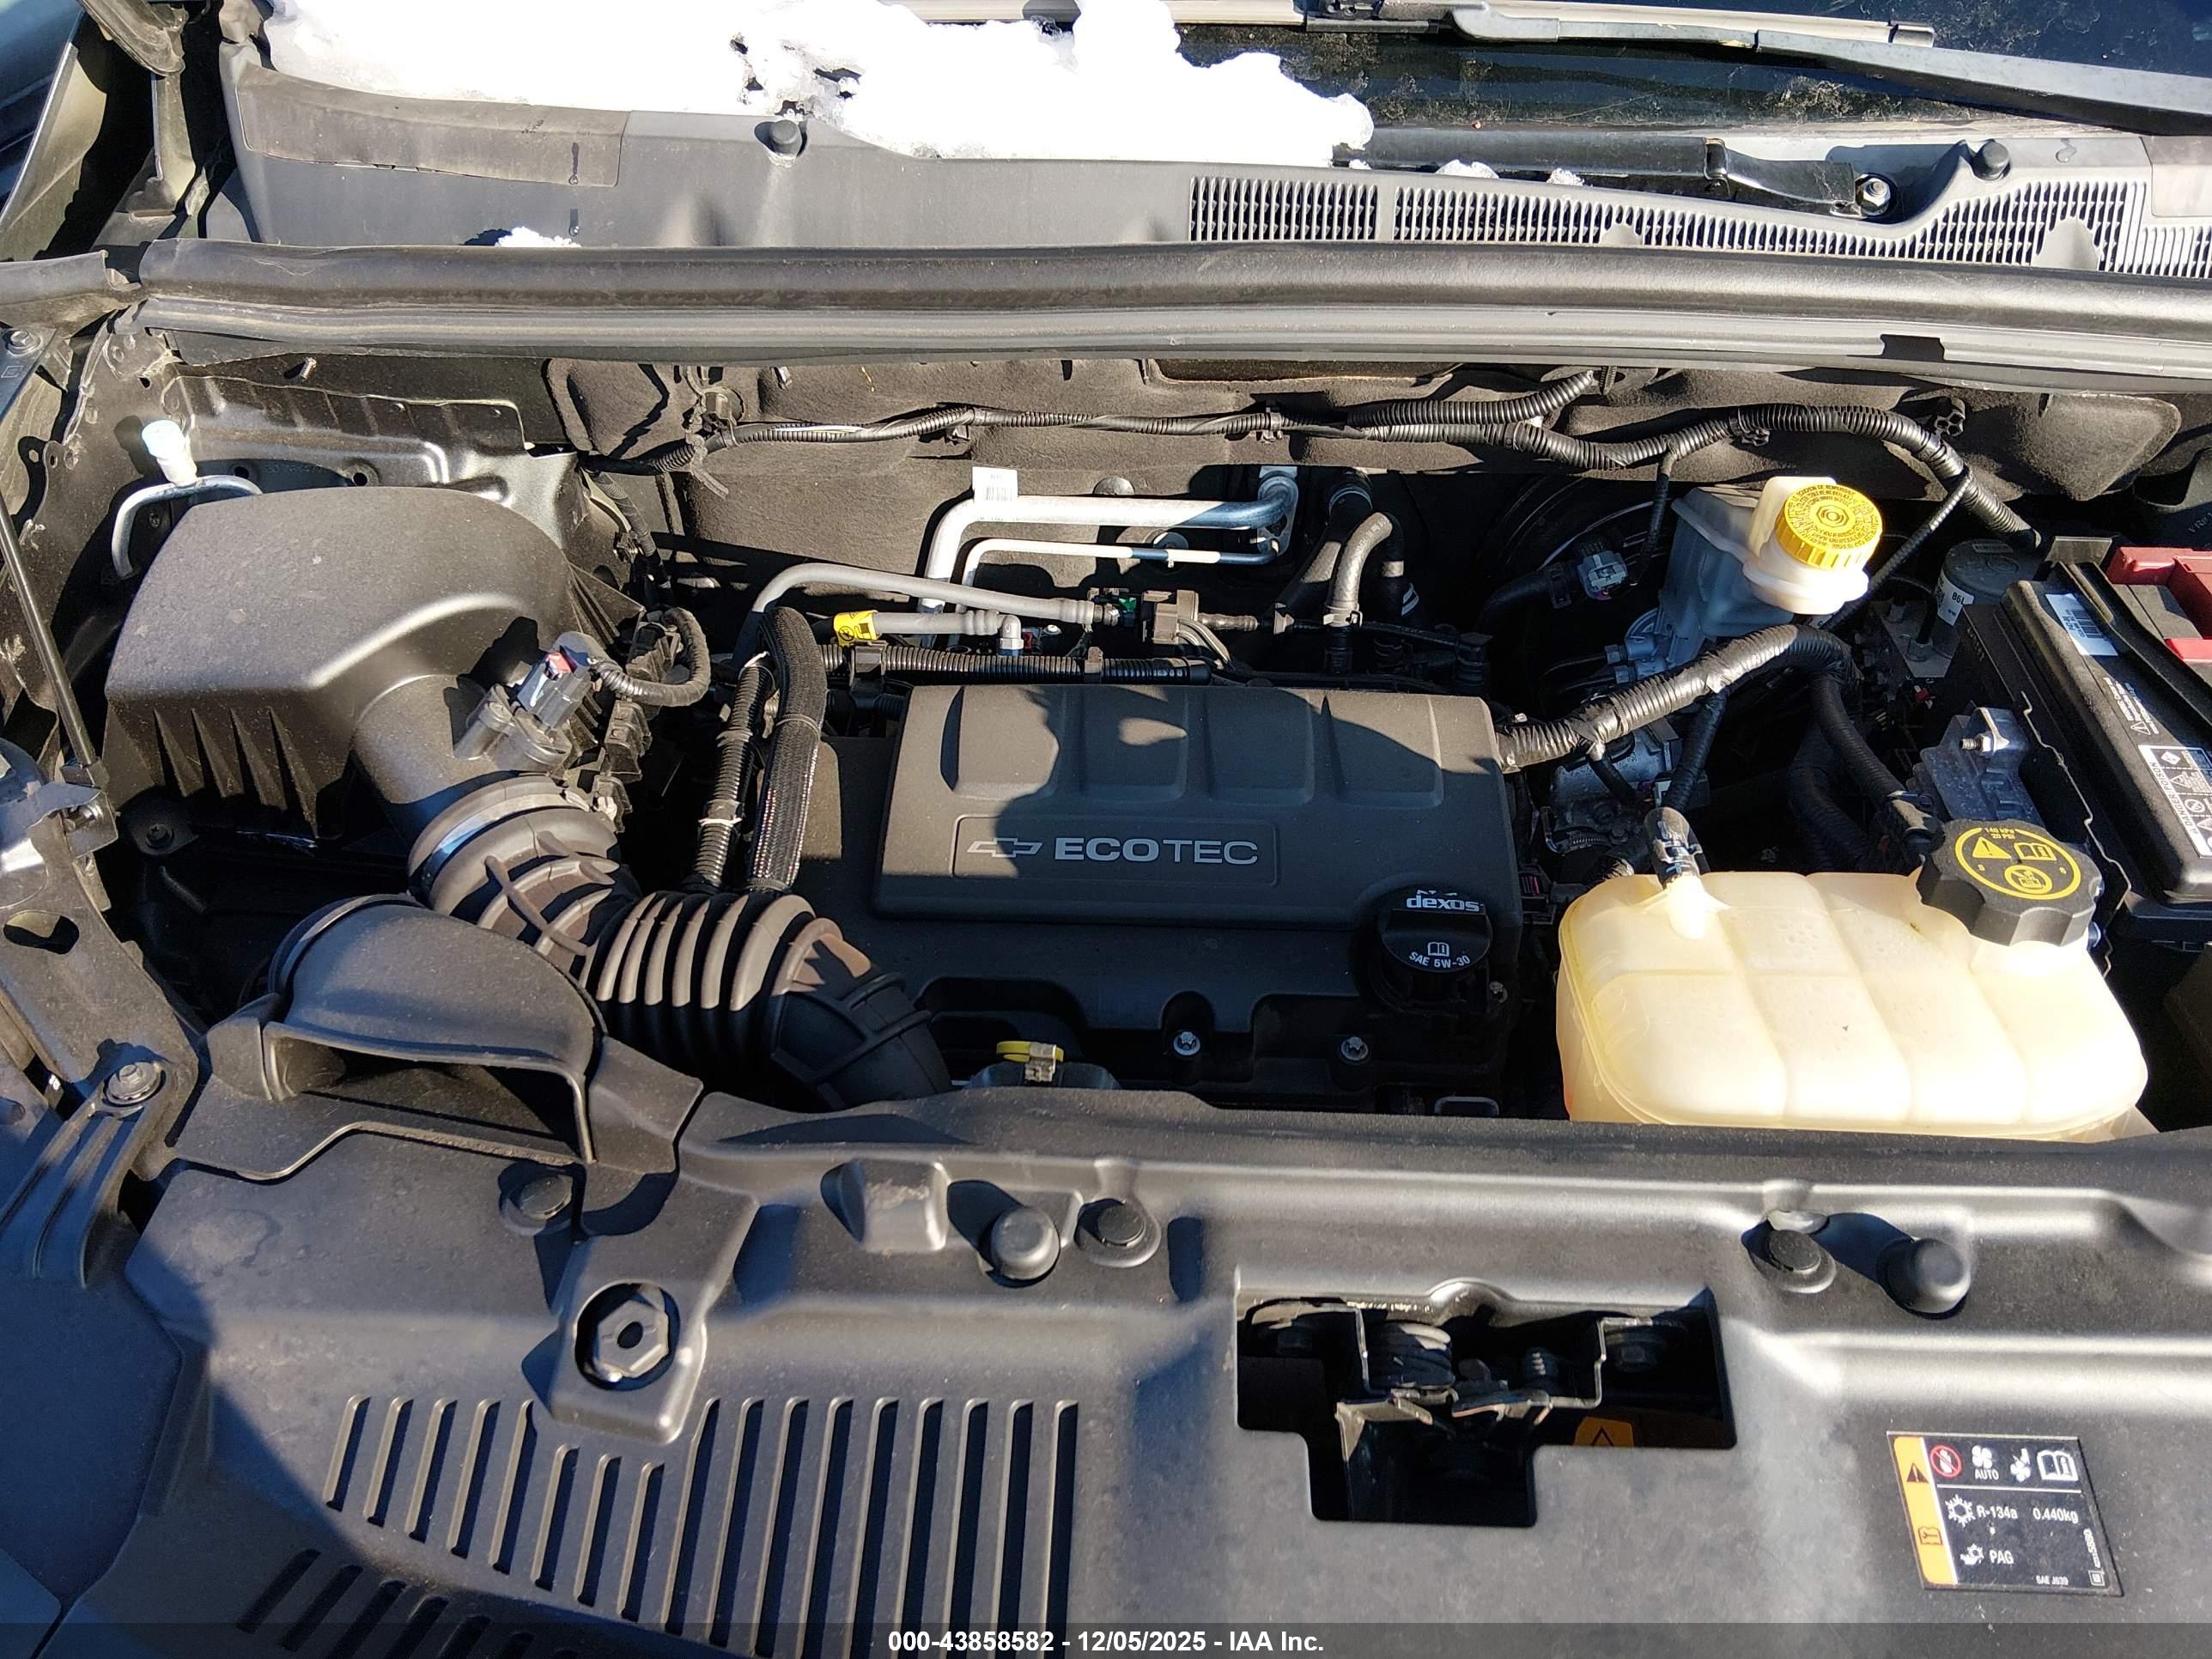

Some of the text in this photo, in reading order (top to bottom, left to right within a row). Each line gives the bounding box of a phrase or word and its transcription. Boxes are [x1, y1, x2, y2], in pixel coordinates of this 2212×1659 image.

[1055, 837, 1258, 865] ECOTEC
[1406, 895, 1480, 912] dexos
[1408, 951, 1471, 969] SAE 5W-30
[1974, 1468, 2000, 1480] AUTO
[1976, 1504, 2079, 1524] R-134a 0.440kg
[1989, 1550, 2014, 1565] PAG
[2035, 1575, 2051, 1585] SAE
